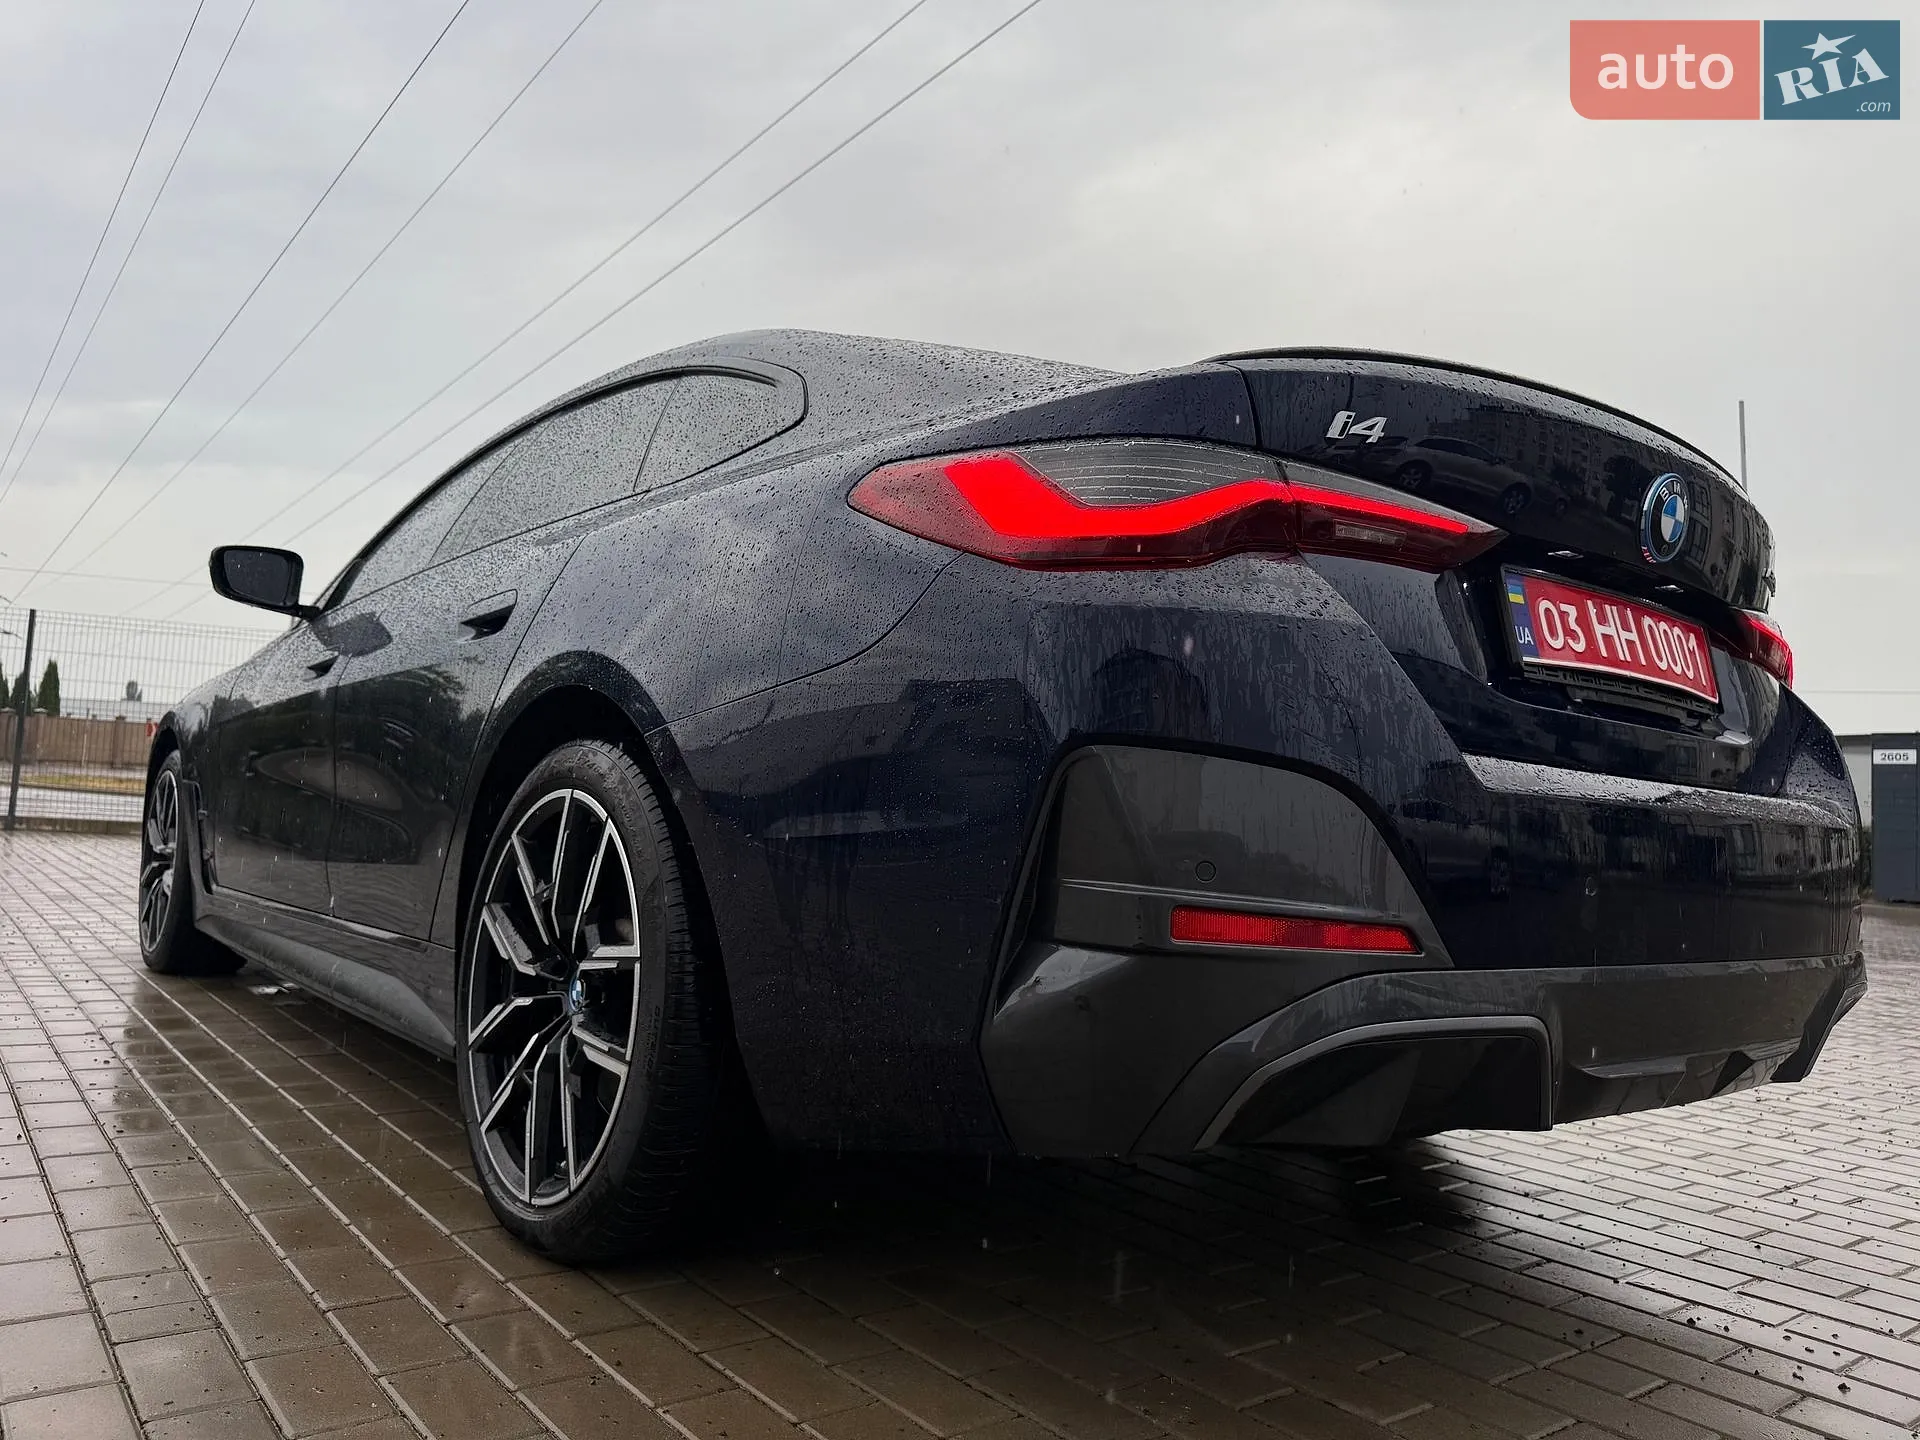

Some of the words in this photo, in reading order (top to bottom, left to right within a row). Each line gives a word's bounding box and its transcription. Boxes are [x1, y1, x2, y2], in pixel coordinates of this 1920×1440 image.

[1325, 410, 1388, 443] i4
[1515, 625, 1534, 646] UA
[1538, 599, 1586, 653] 03
[1587, 599, 1646, 666] HH
[1642, 614, 1706, 686] 0001
[1880, 752, 1909, 762] 2605
